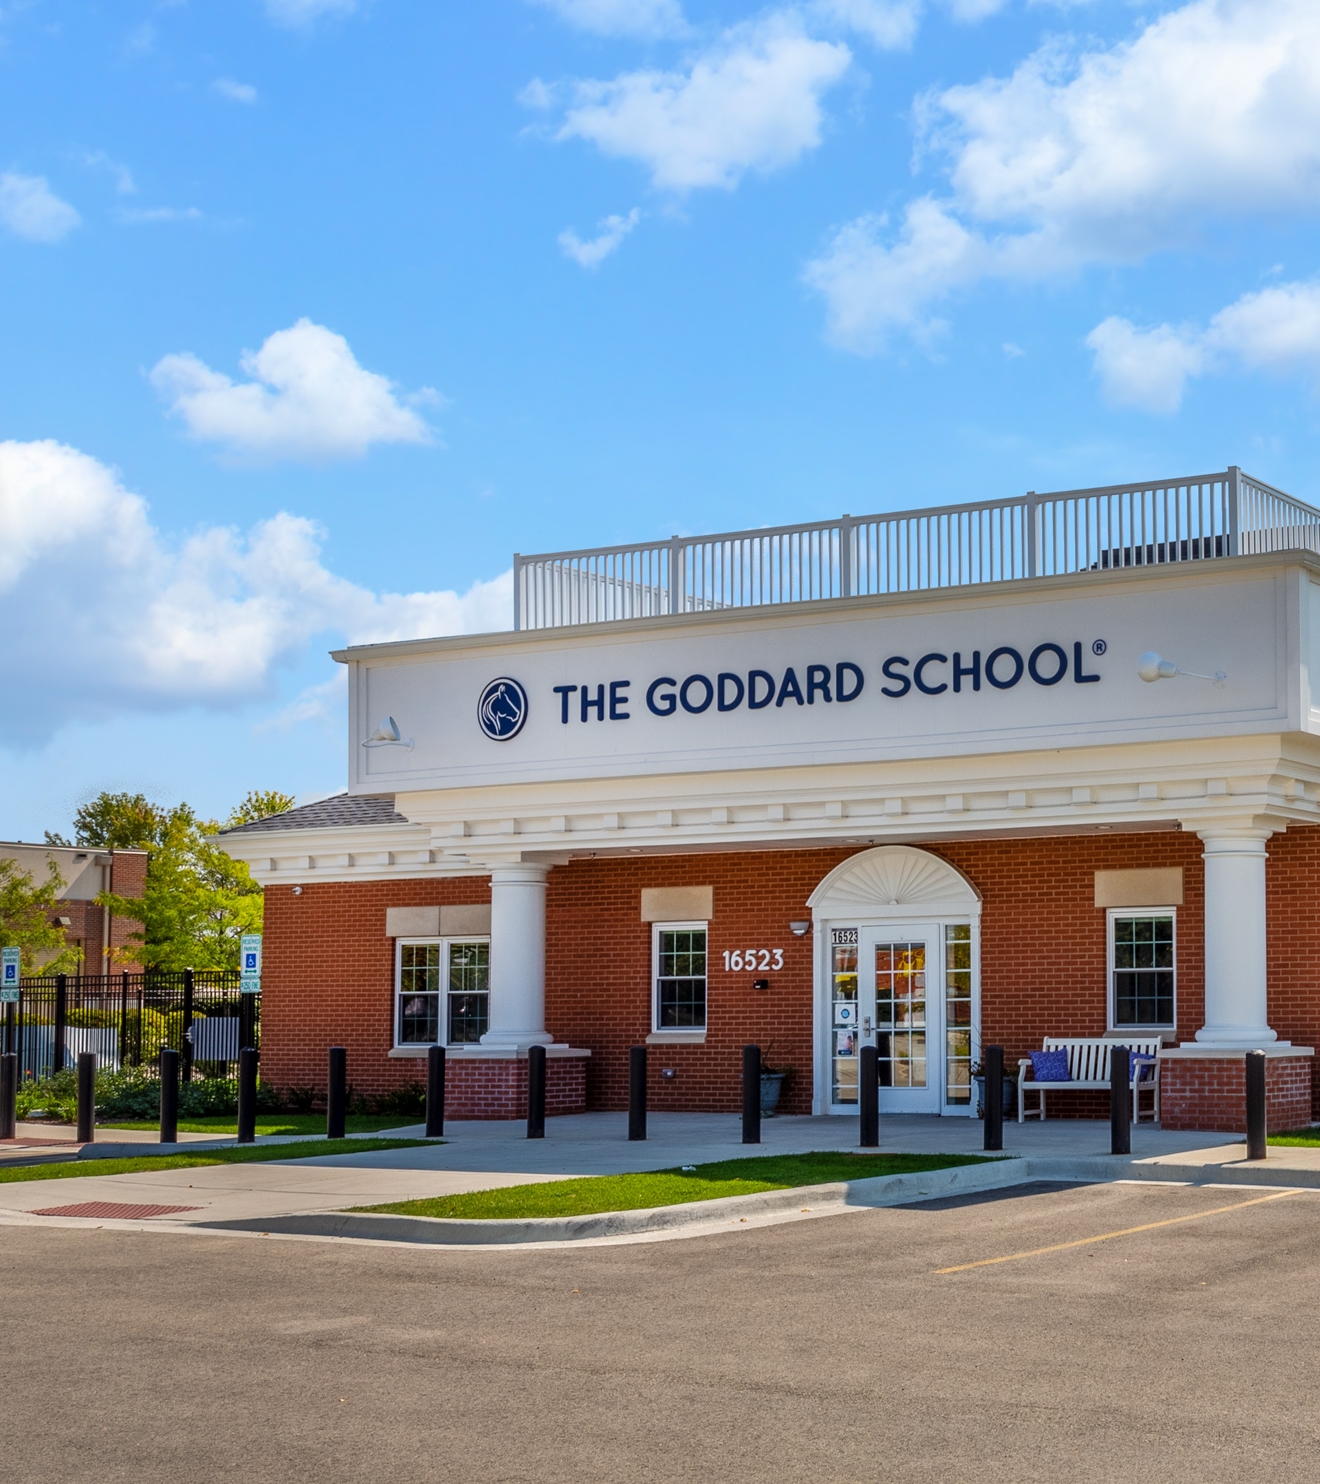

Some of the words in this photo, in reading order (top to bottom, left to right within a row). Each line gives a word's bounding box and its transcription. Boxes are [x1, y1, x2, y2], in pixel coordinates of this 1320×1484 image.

[553, 680, 631, 724] THE
[646, 661, 865, 717] GODDARD
[832, 931, 858, 943] 16523
[722, 948, 784, 972] 16523
